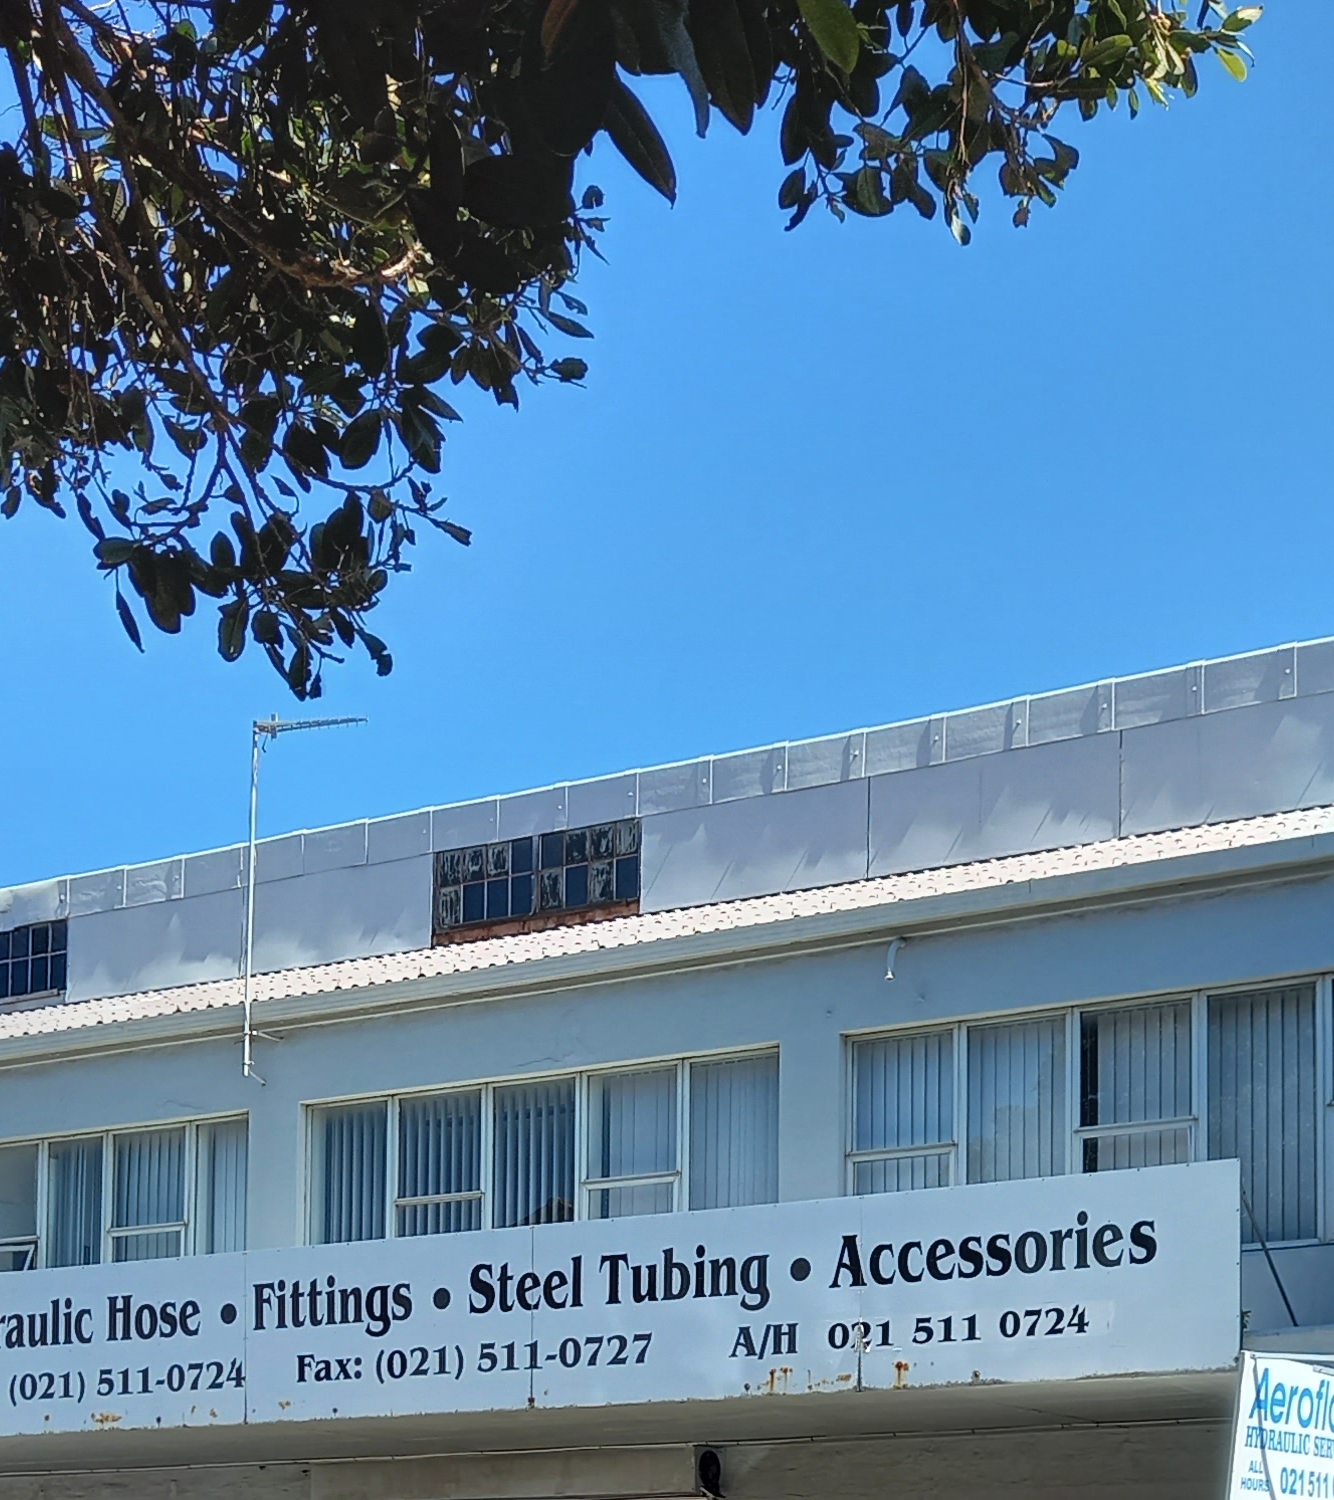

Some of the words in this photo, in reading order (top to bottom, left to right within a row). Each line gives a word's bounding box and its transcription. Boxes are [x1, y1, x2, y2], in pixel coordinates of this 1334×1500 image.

[105, 1294, 201, 1341] Hose
[252, 1274, 413, 1337] Fittings
[468, 1254, 584, 1315] Steel
[598, 1244, 771, 1312] Tubing
[828, 1210, 1158, 1289] Accessories
[8, 1370, 86, 1407] (021)
[96, 1357, 246, 1397] 511-0724
[296, 1353, 363, 1383] Fax:
[375, 1344, 465, 1385] (021)
[477, 1331, 654, 1373] 511-0727
[728, 1322, 799, 1360] A/H
[827, 1319, 894, 1350] 021
[911, 1313, 982, 1345] 511
[998, 1303, 1090, 1337] 0724
[1244, 1425, 1311, 1456] HYDRAULIC
[1248, 1459, 1264, 1474] ALL
[1240, 1476, 1270, 1493] HOURS
